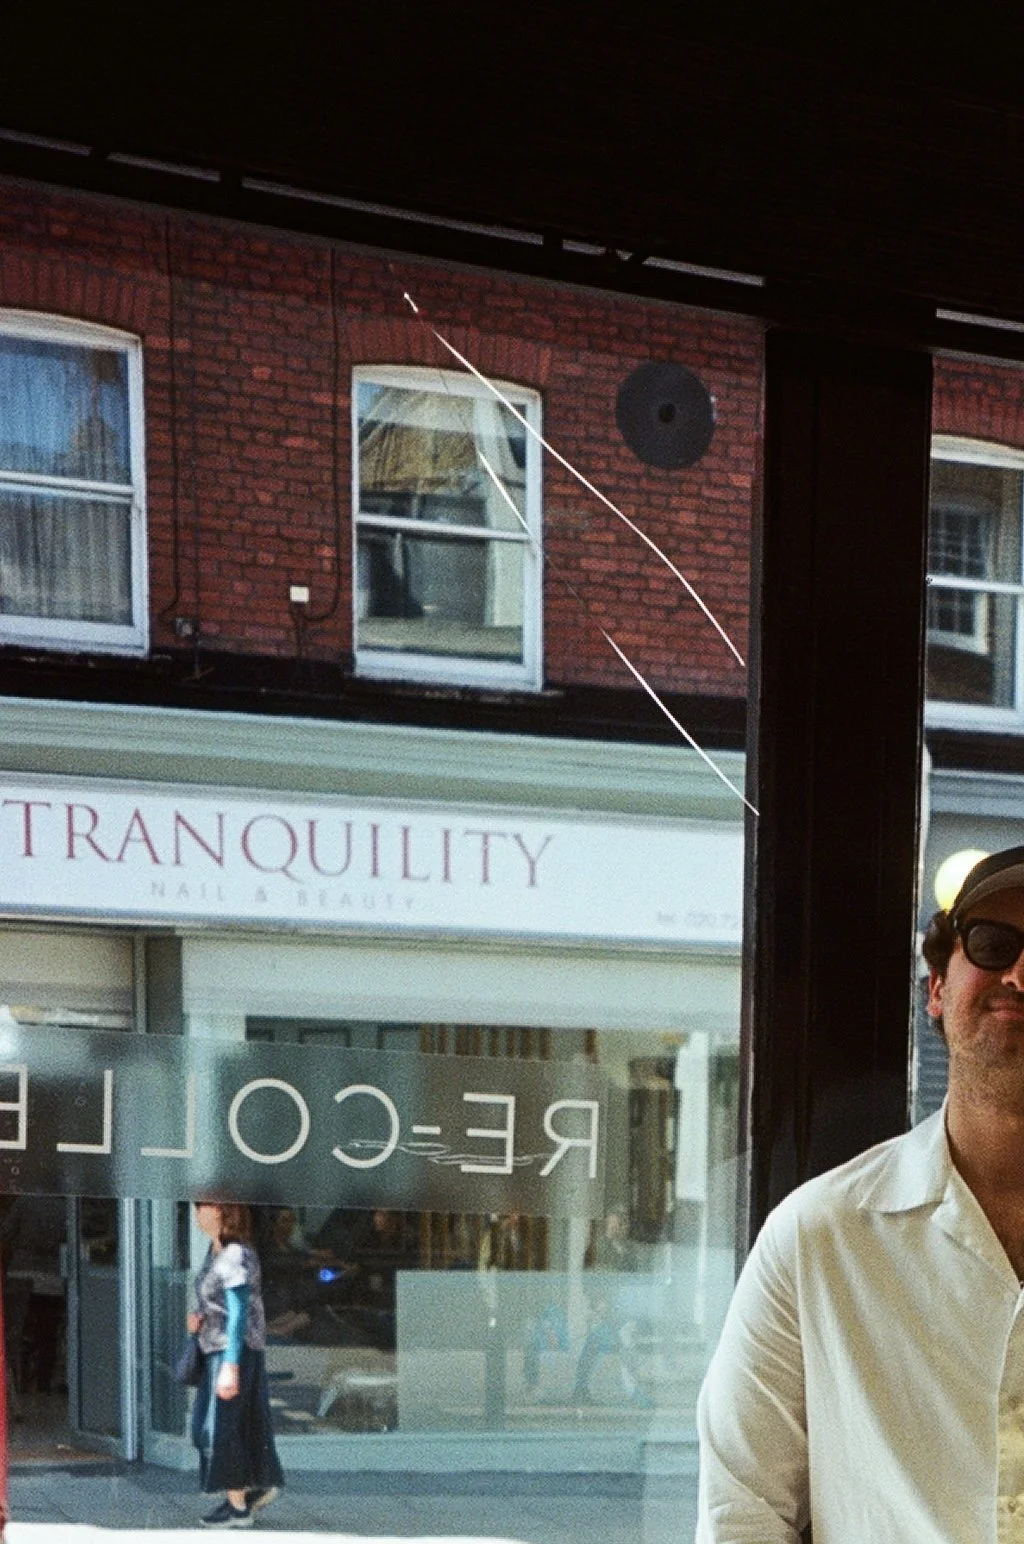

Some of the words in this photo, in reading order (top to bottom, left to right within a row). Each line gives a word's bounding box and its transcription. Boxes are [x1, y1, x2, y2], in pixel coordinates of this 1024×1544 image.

[3, 799, 554, 888] TRANQUILITY
[150, 881, 224, 902] NAIL
[297, 888, 413, 911] BEAUTY
